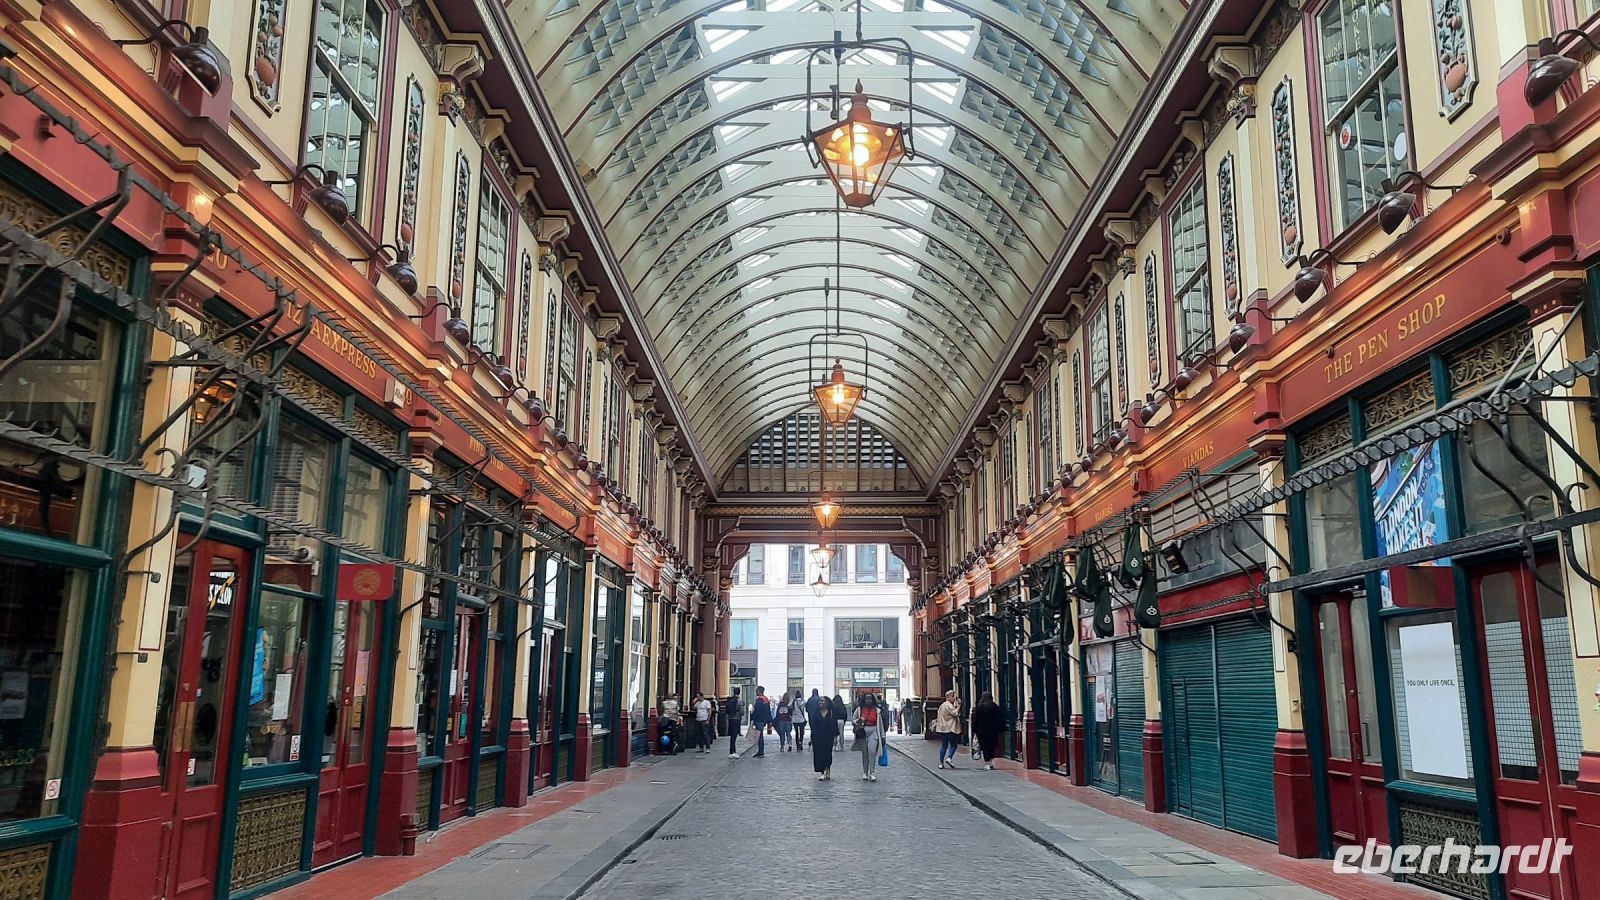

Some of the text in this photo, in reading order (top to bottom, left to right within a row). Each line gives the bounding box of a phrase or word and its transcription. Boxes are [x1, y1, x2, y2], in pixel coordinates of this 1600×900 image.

[283, 299, 377, 379] IZAEXPRESS
[1324, 294, 1446, 384] THE PEN SHOP
[1183, 441, 1214, 468] VIANDAS
[1382, 476, 1419, 537] LONDON
